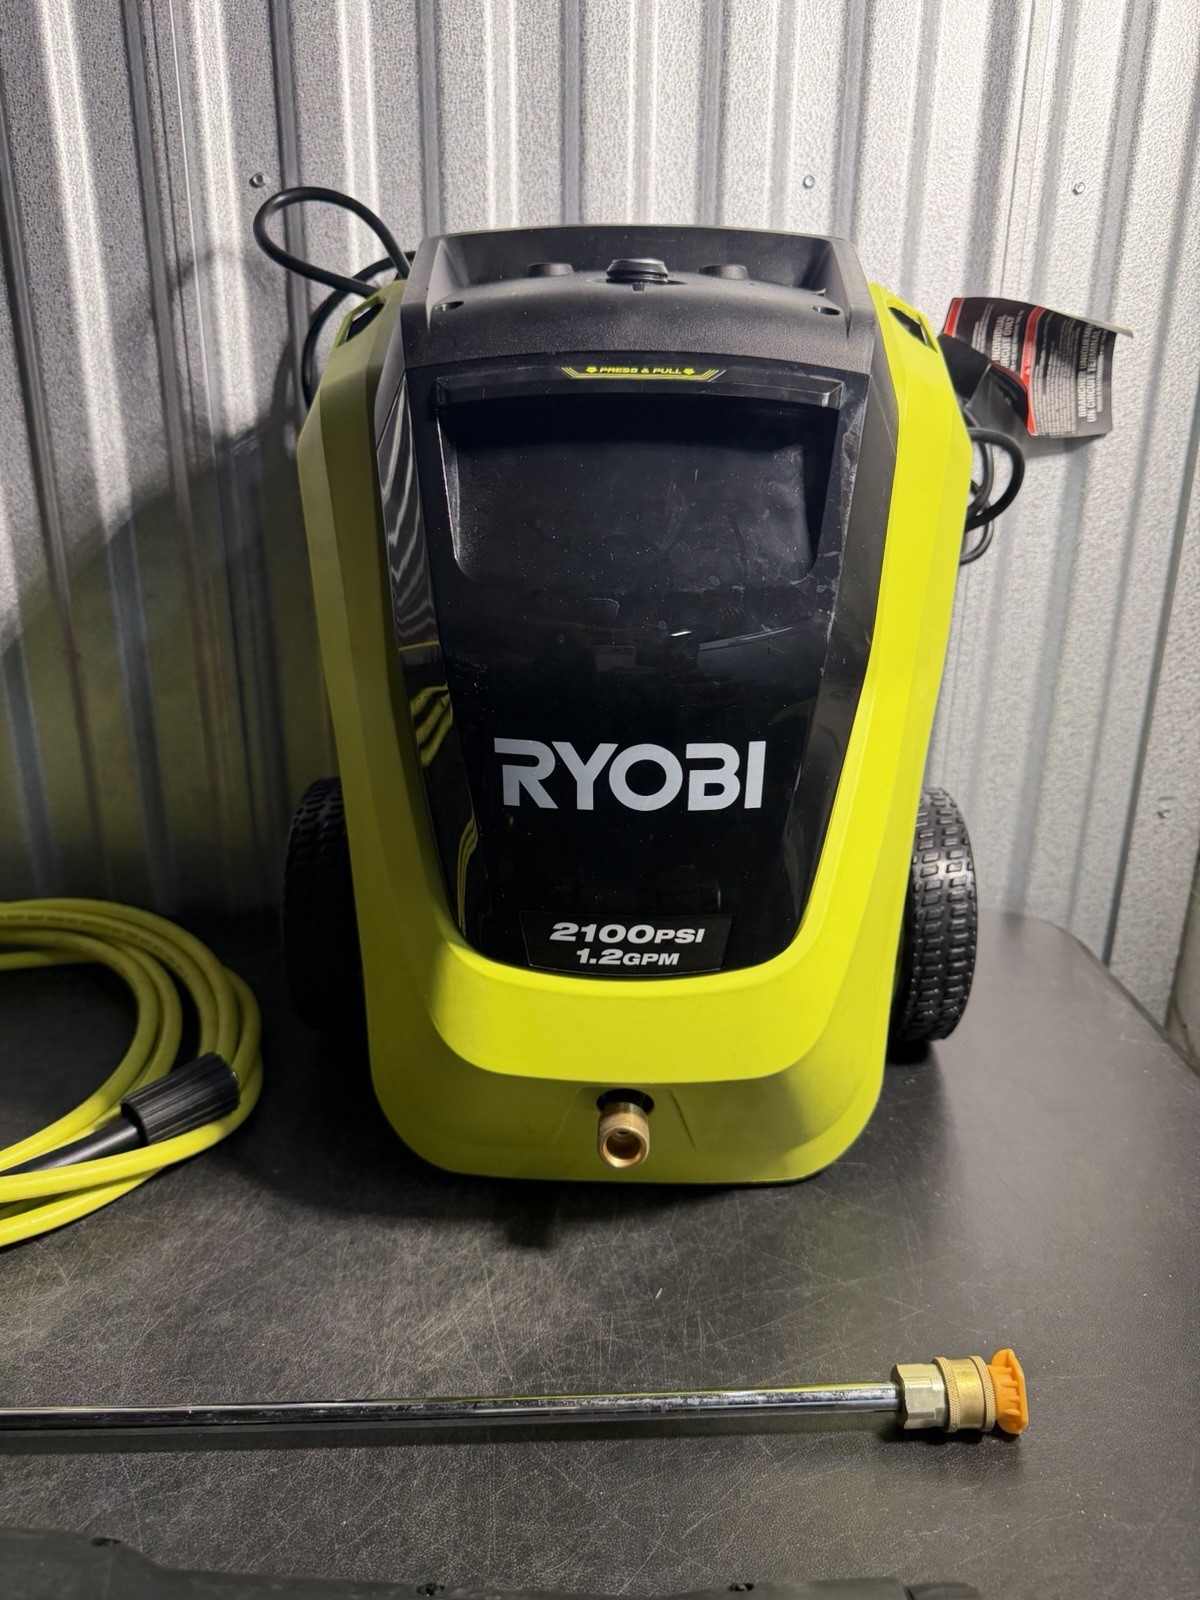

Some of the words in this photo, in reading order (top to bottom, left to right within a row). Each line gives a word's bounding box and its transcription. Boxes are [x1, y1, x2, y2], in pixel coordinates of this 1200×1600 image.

[991, 314, 1006, 361] INDIVIDUAL
[1003, 316, 1015, 335] ONLY
[1000, 336, 1012, 369] IRCUIT
[1087, 329, 1102, 373] TERMINAL
[641, 366, 649, 374] &
[653, 367, 682, 375] PULL
[1078, 372, 1087, 418] BRANCHER
[1087, 373, 1097, 408] CIRCUIT
[494, 737, 766, 811] RYOBI
[549, 922, 705, 944] 2100PSI
[576, 948, 680, 966] 1.2GPM
